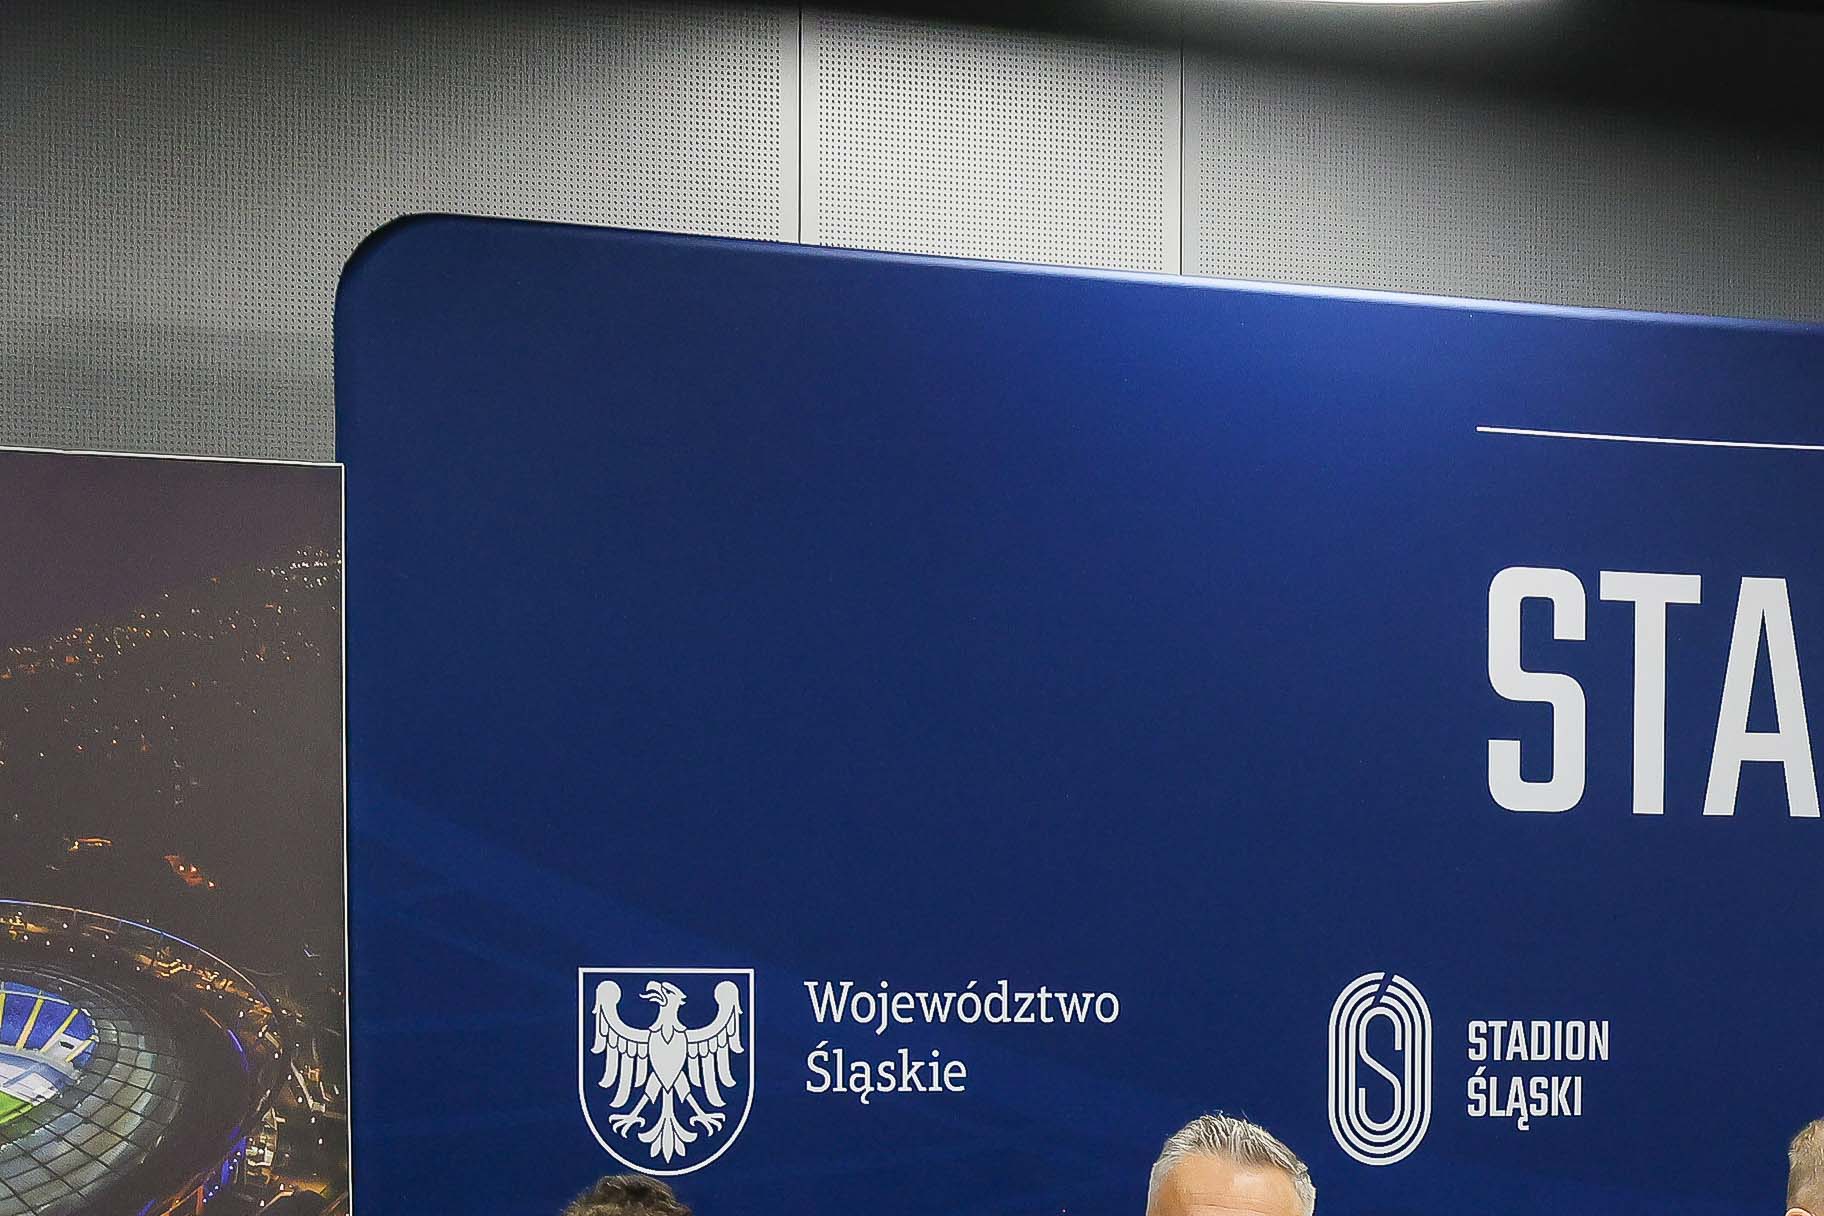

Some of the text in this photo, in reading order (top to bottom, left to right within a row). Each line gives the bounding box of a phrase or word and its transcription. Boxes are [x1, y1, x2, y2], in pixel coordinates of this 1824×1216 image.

[803, 979, 1120, 1036] Województwo
[1468, 1020, 1609, 1061] STADION
[805, 1041, 967, 1105] Śląskie
[1467, 1065, 1582, 1131] ŚLĄSKI
